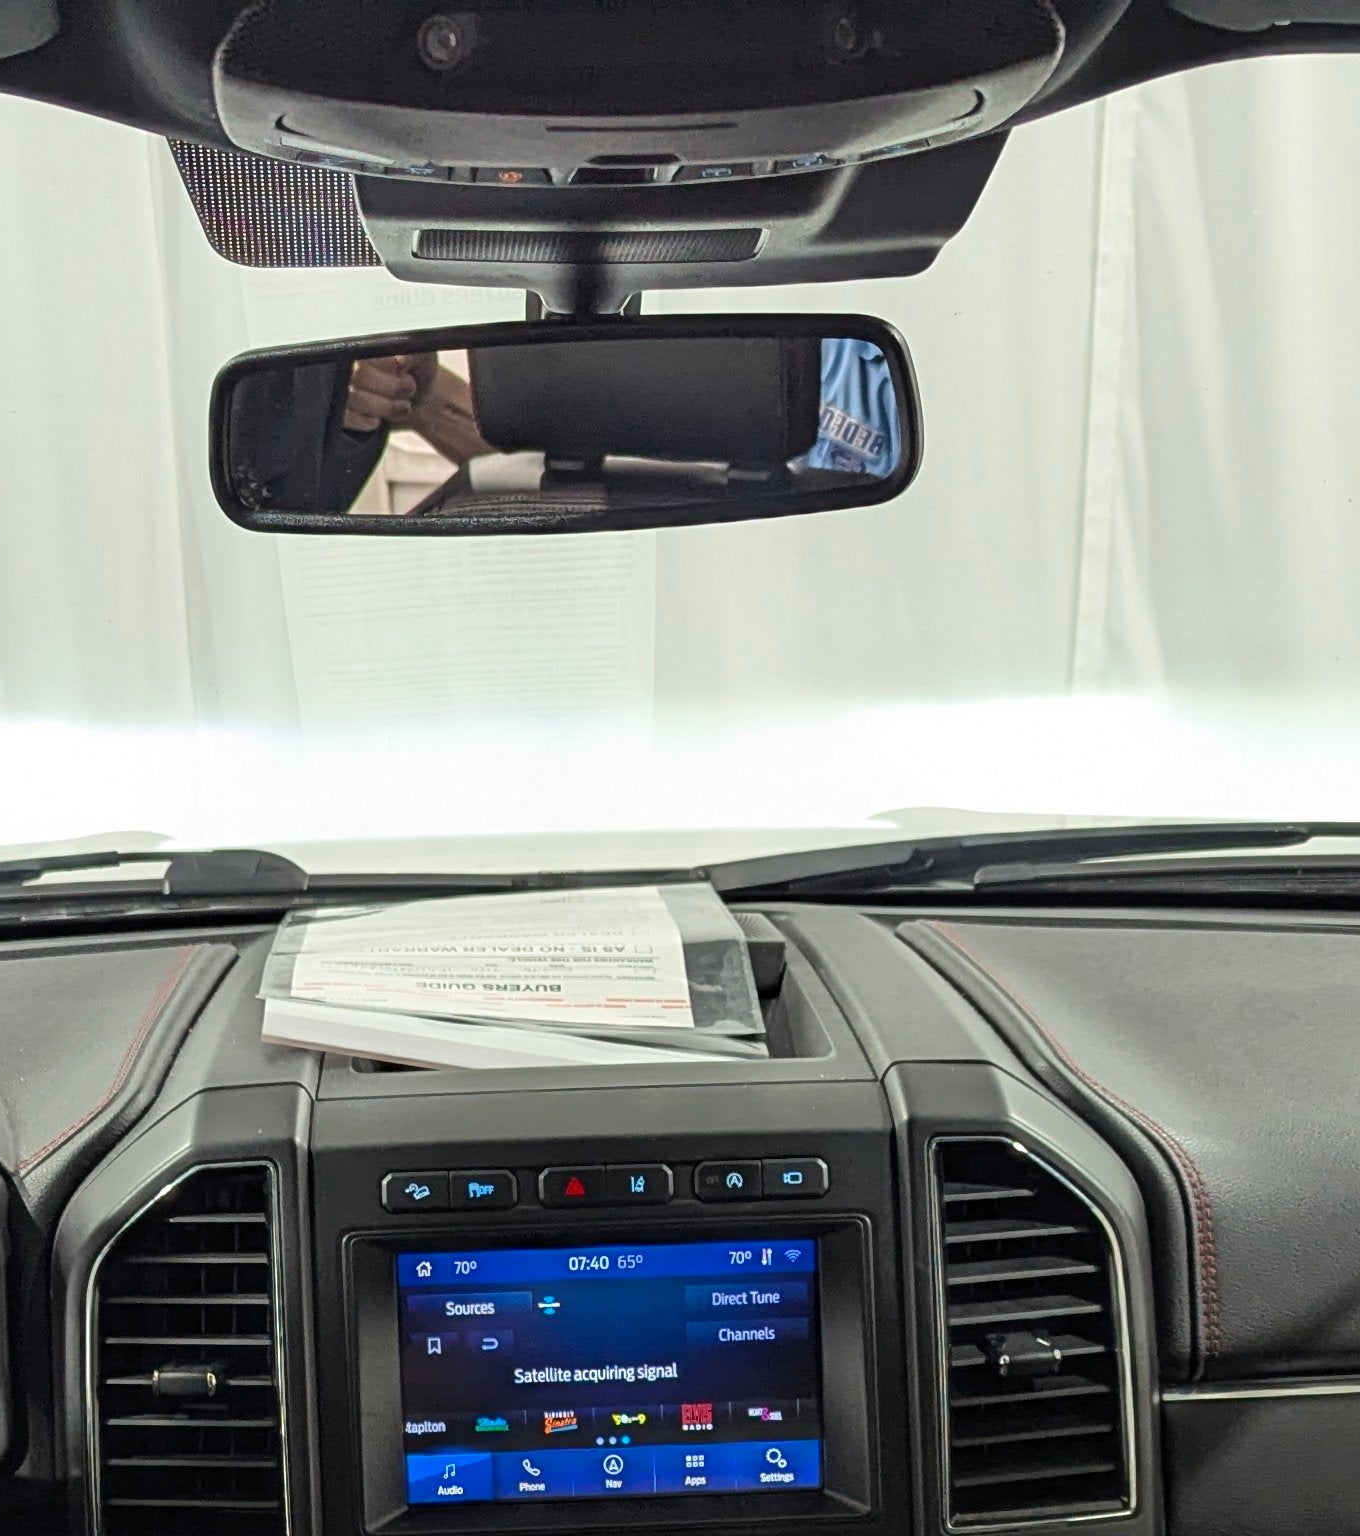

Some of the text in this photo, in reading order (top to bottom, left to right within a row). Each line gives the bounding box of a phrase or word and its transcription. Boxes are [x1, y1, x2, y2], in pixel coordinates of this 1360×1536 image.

[416, 981, 562, 993] BUYERS GUIDE
[568, 1256, 610, 1271] 07:40
[711, 1290, 780, 1306] Direct Tune
[445, 1301, 495, 1316] Sources
[718, 1327, 776, 1342] Channels
[514, 1361, 679, 1384] Satellite acquiring signal
[681, 1403, 713, 1424] ELVIS
[605, 1479, 623, 1489] Nav
[684, 1476, 707, 1487] Apps
[759, 1472, 795, 1484] Settings
[437, 1485, 464, 1496] Audio
[519, 1481, 546, 1492] Phone
